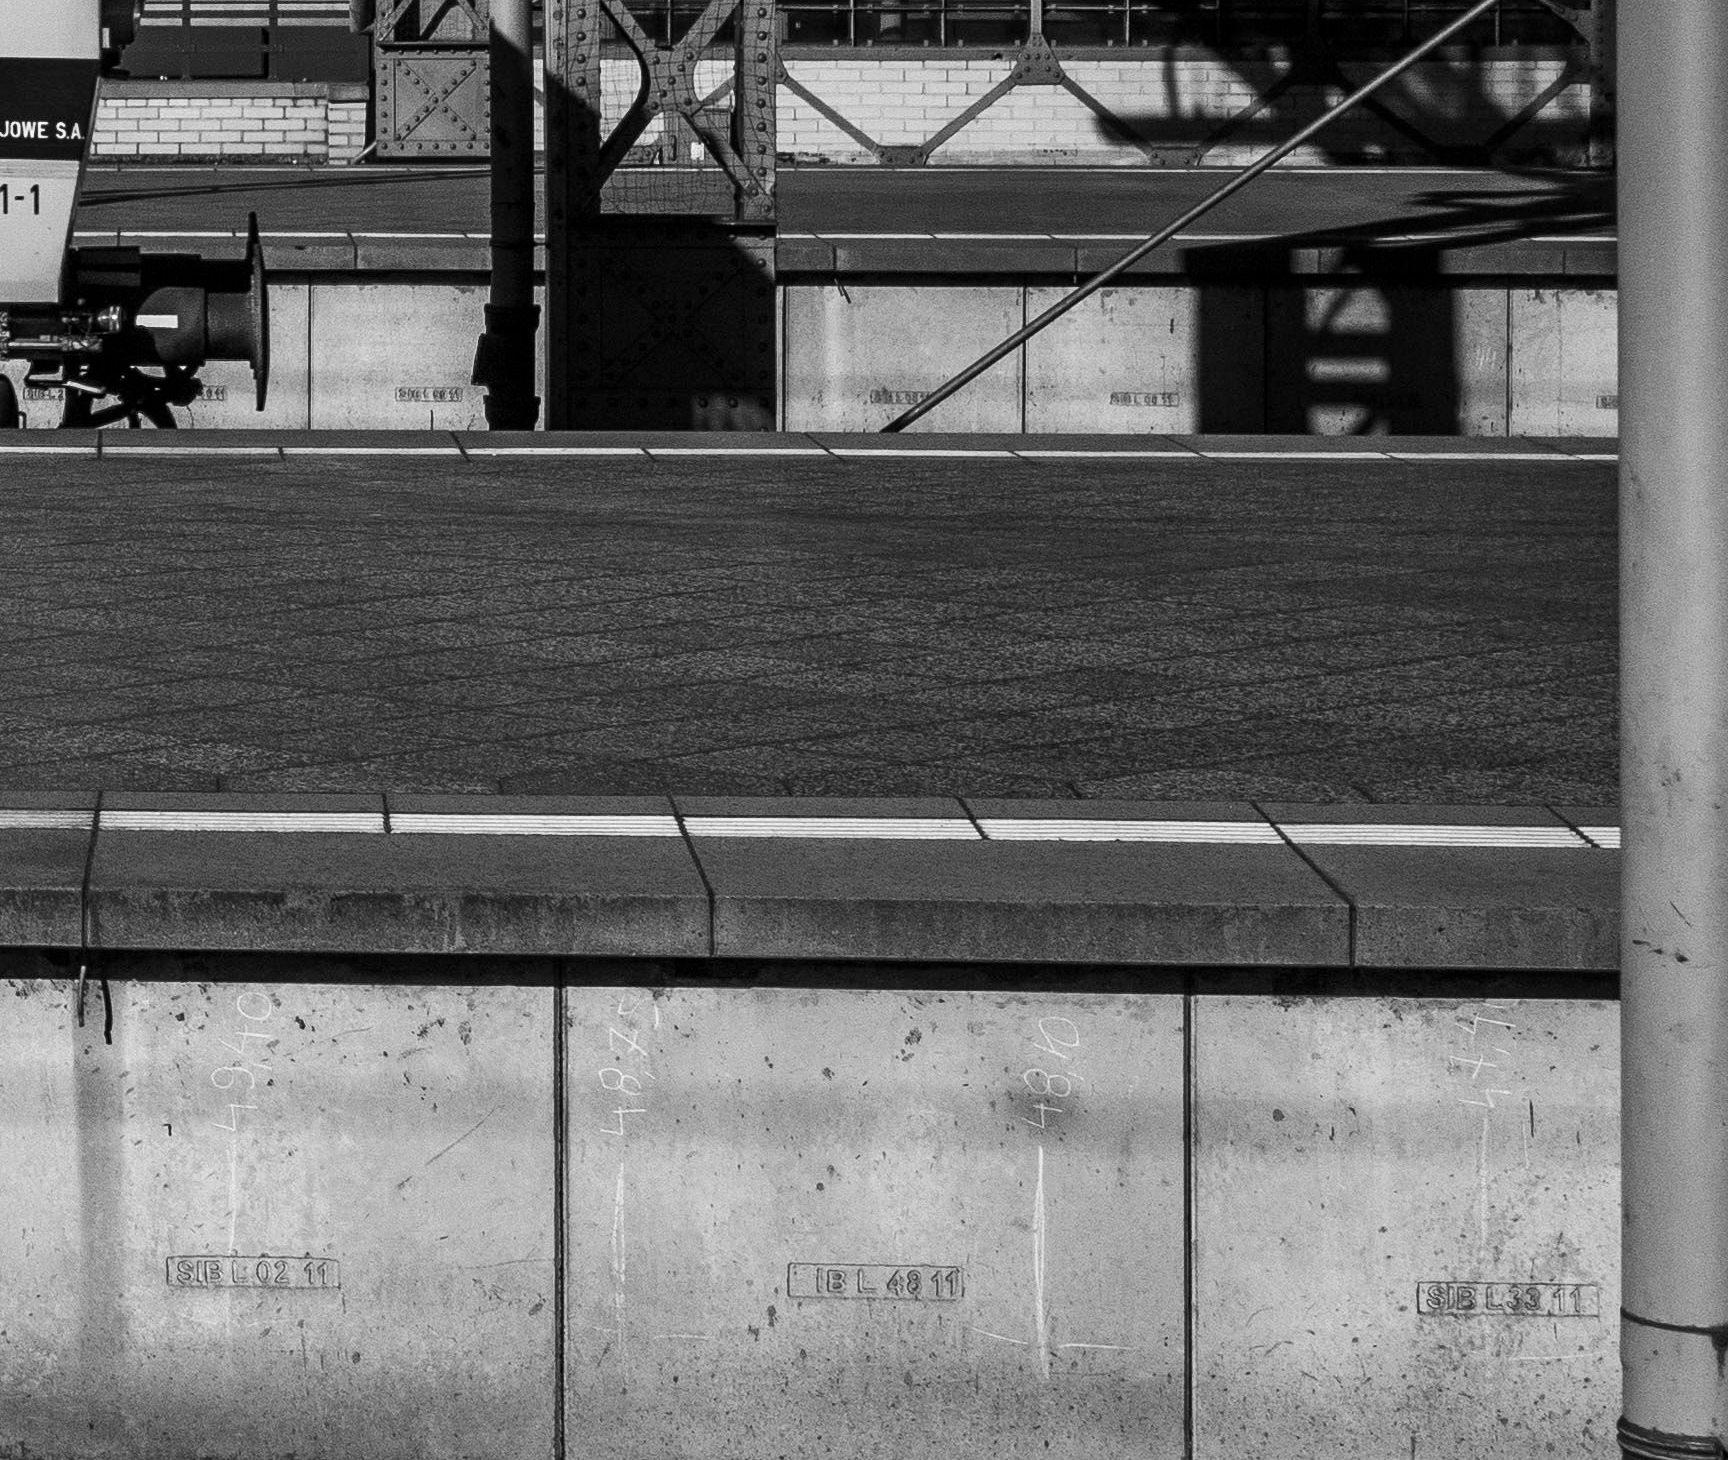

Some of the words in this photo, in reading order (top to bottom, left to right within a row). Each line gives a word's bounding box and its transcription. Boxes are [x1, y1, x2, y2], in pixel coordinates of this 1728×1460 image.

[55, 122, 85, 140] S.A.
[177, 1259, 225, 1285] SIB
[231, 1259, 248, 1284] L
[256, 1260, 290, 1284] 02
[303, 1261, 329, 1286] 11
[856, 1268, 878, 1294] L
[930, 1270, 960, 1297] 11
[1426, 1283, 1477, 1311] SIB
[1552, 1286, 1582, 1314] 11
